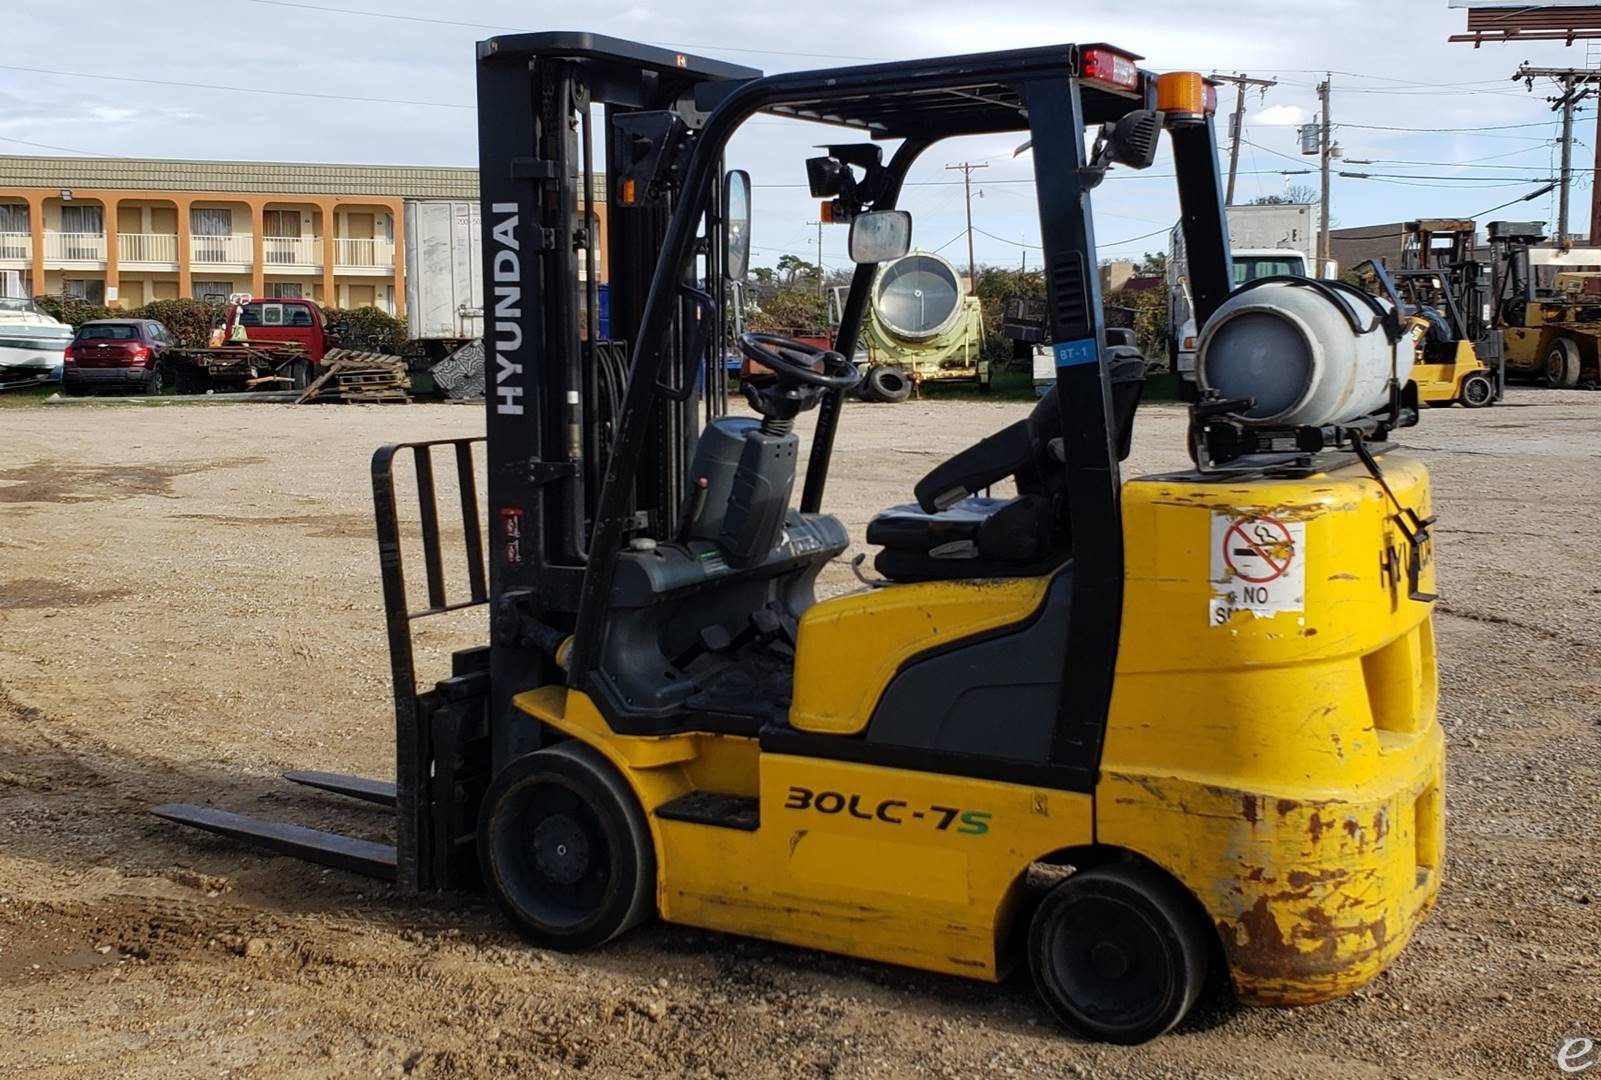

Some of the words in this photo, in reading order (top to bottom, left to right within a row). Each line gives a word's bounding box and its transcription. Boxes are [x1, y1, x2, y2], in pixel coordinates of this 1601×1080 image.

[492, 202, 524, 415] HYUNDAI
[1060, 346, 1087, 360] BT-1
[1243, 586, 1268, 604] NO
[784, 786, 993, 835] 30LC-7S
